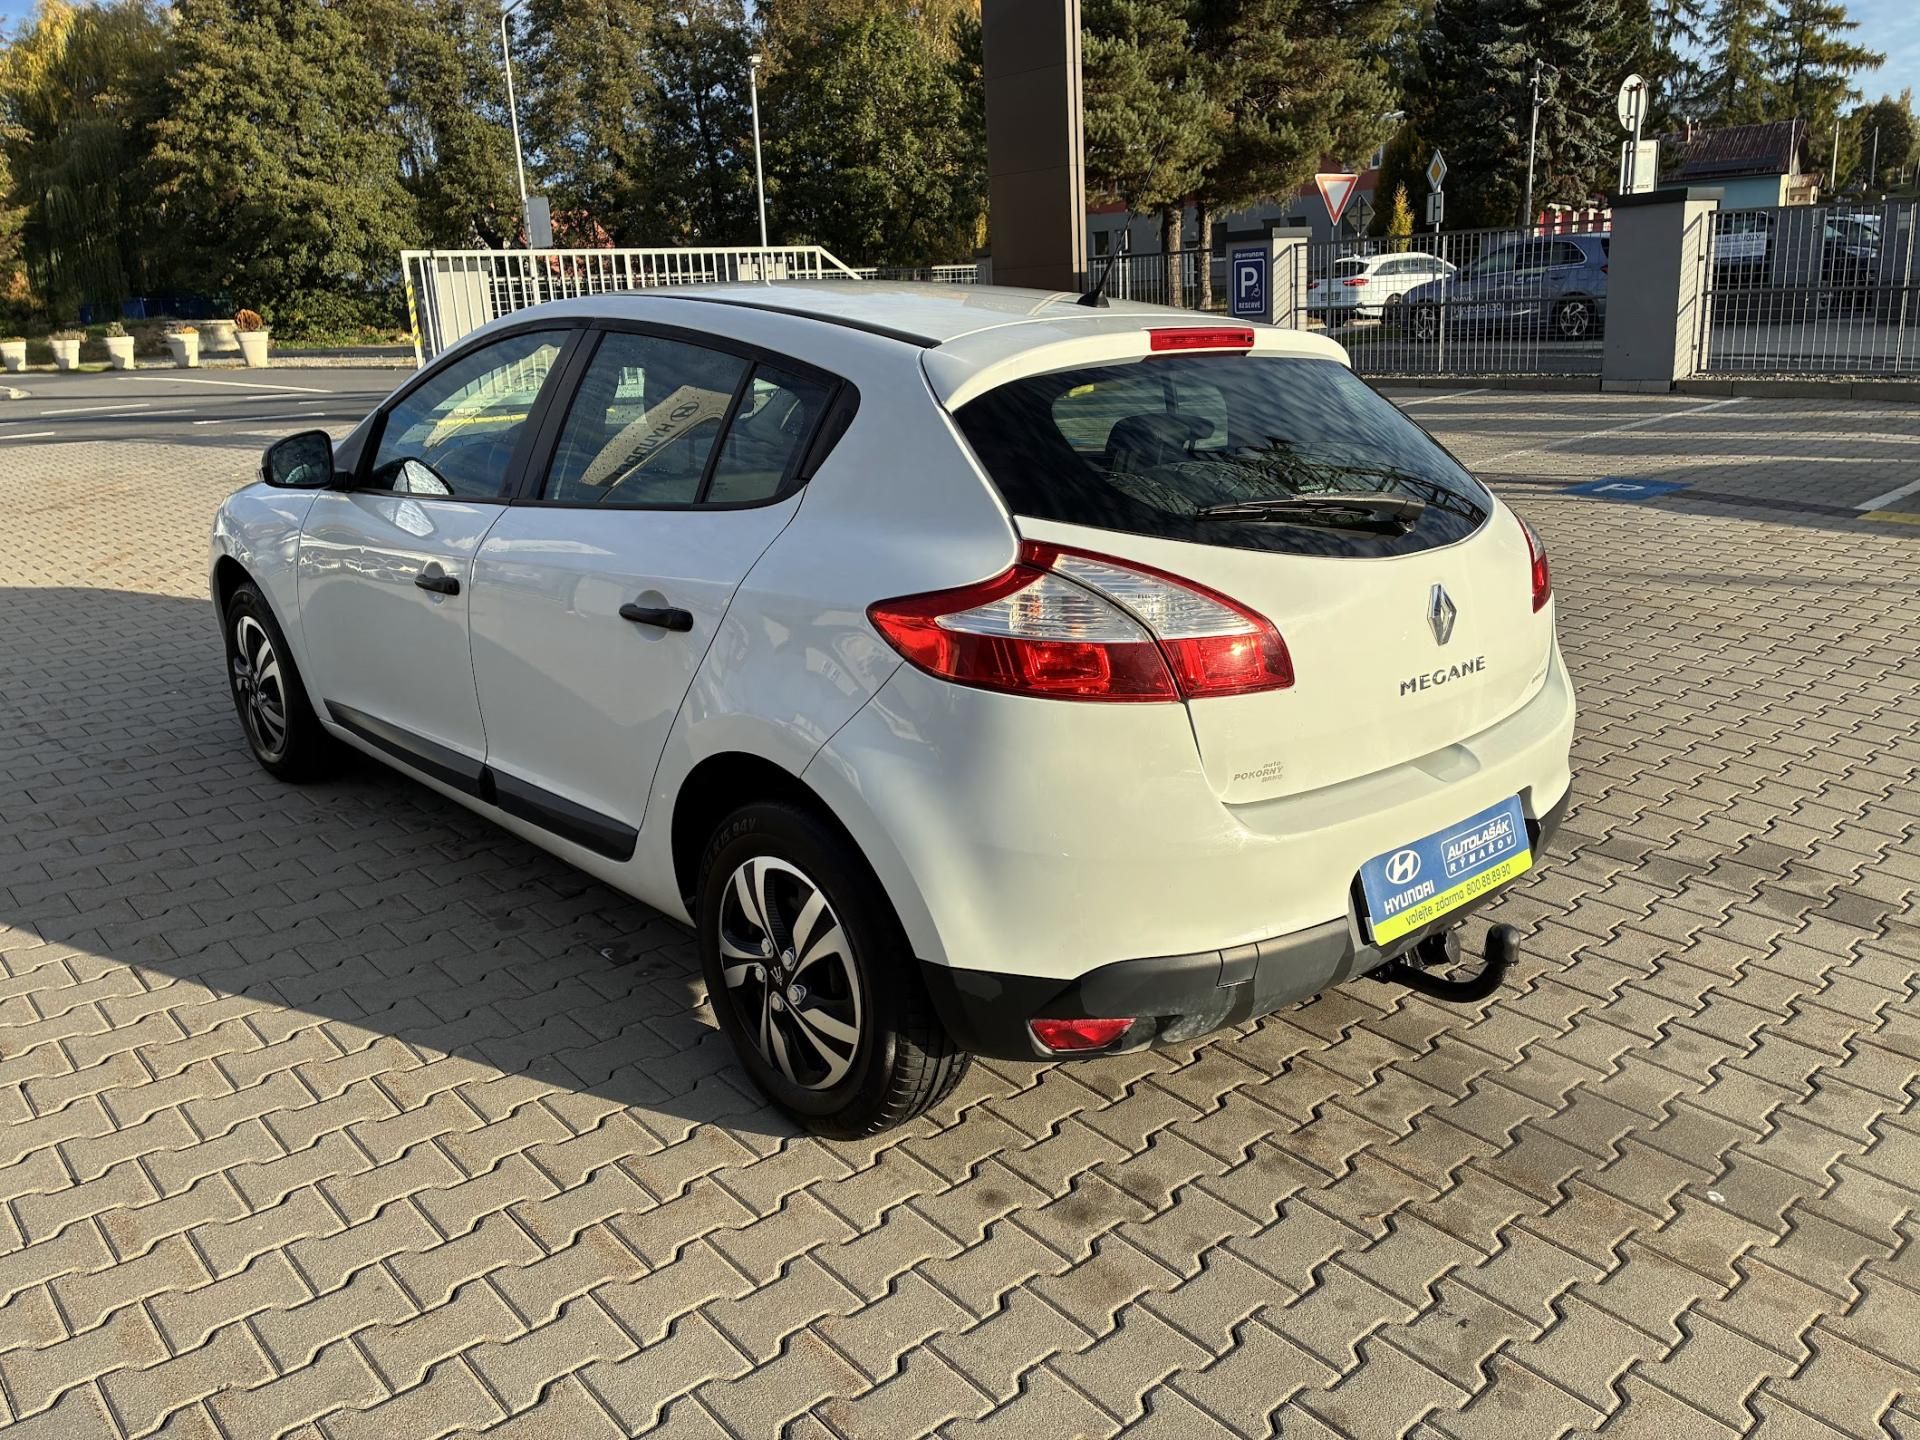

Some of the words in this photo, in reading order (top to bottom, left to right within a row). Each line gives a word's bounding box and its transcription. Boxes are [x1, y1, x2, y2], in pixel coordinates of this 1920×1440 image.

[1241, 267, 1258, 298] P
[1400, 655, 1486, 696] MEGANE
[1448, 819, 1509, 860] AUTOLAŠÁK
[1384, 880, 1435, 915] HYUNDAI
[1405, 905, 1433, 926] volejte
[1435, 890, 1465, 912] zdarma
